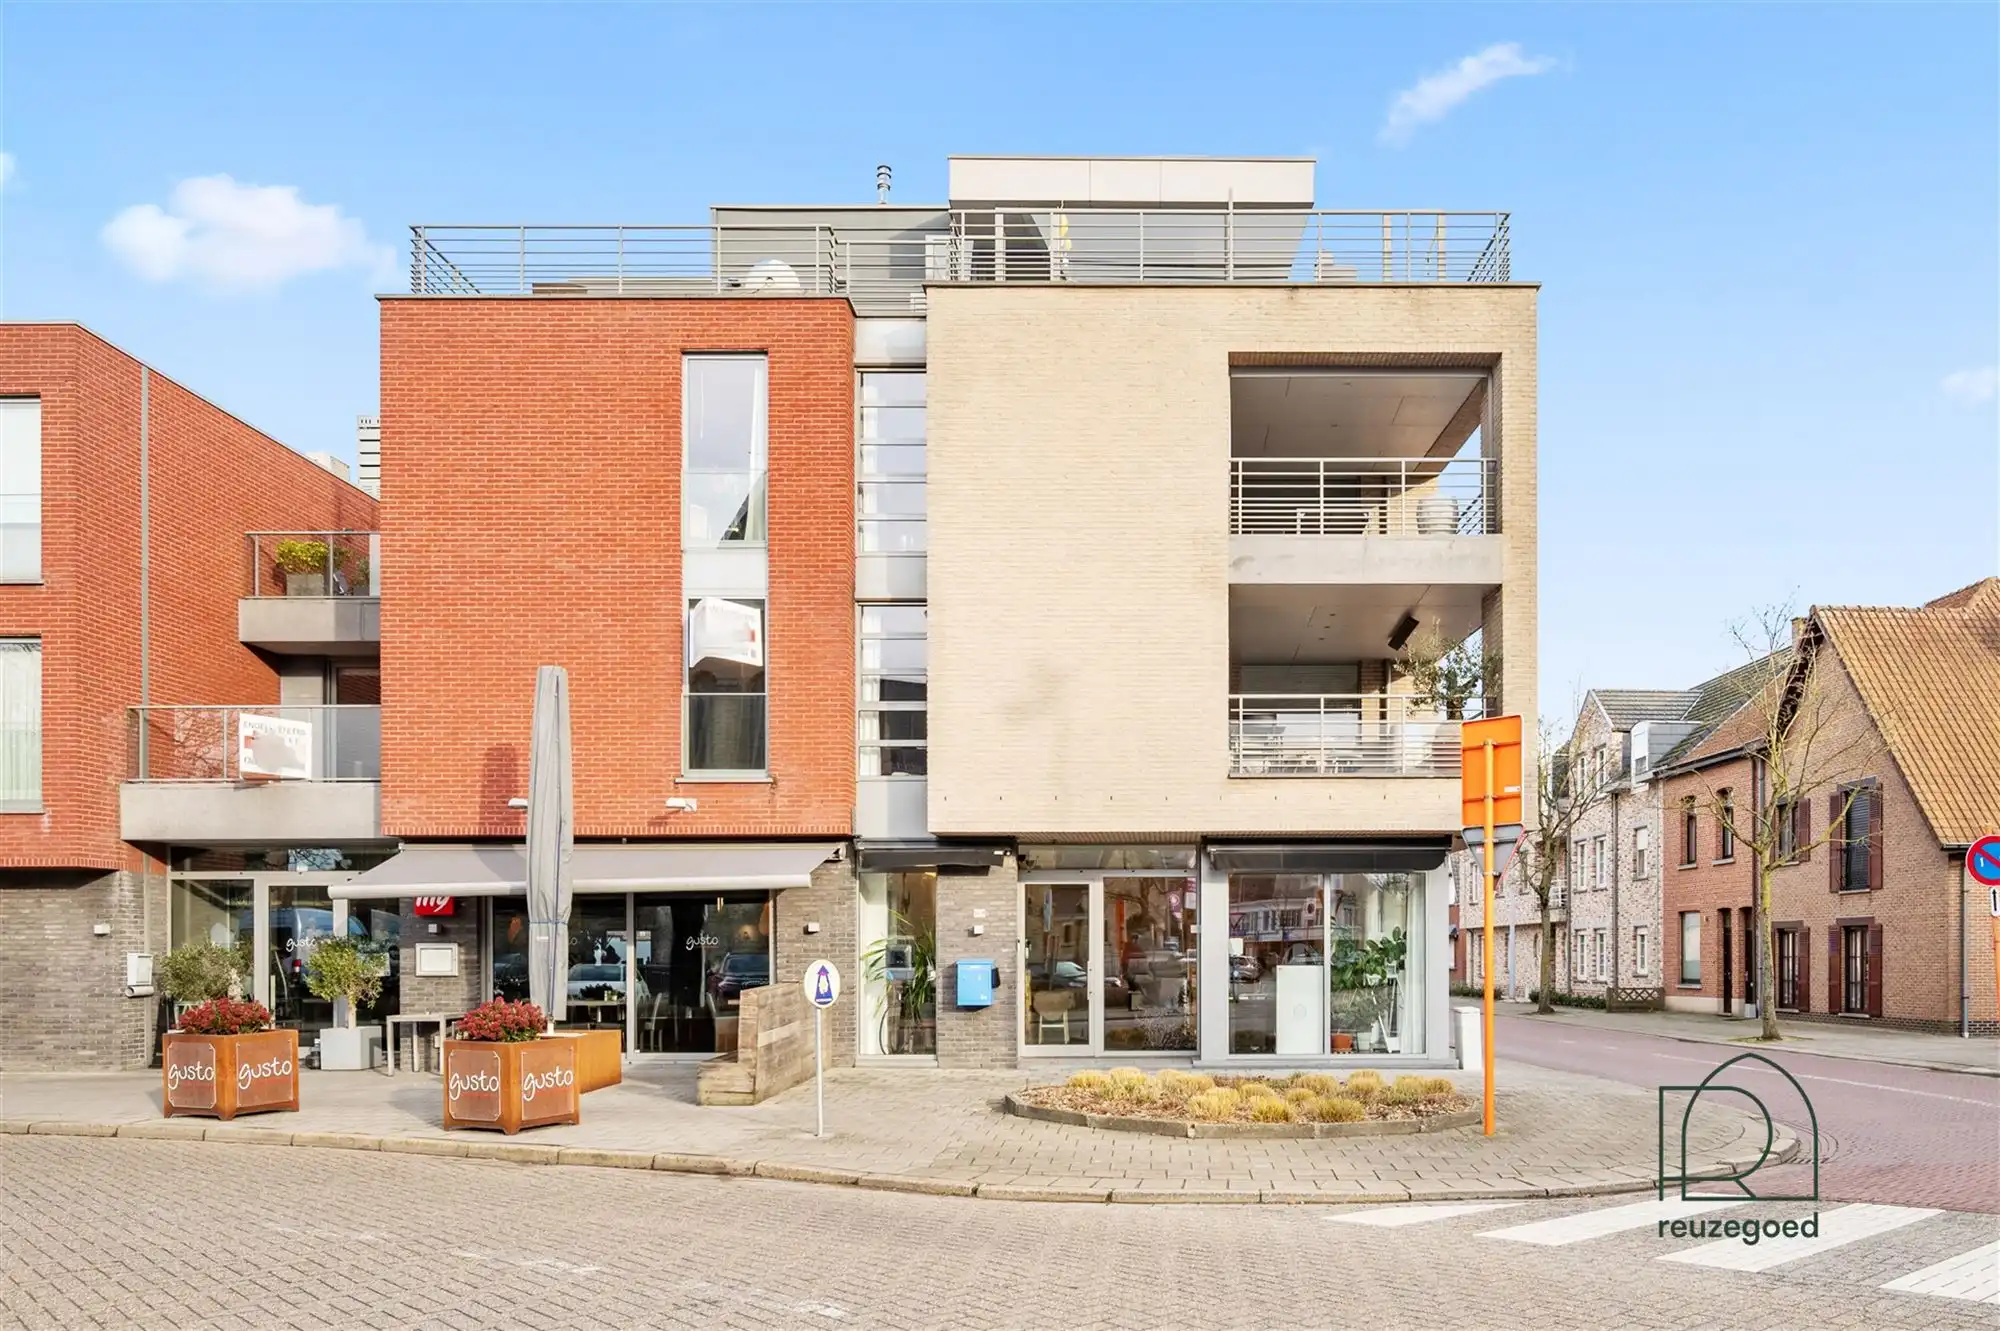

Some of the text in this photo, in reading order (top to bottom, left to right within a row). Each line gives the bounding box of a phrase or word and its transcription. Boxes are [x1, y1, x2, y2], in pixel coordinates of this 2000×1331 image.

[686, 934, 719, 951] gusto
[168, 1060, 215, 1090] gusto
[238, 1056, 293, 1090] gusto
[449, 1070, 500, 1101] gusto
[523, 1065, 574, 1102] gusto
